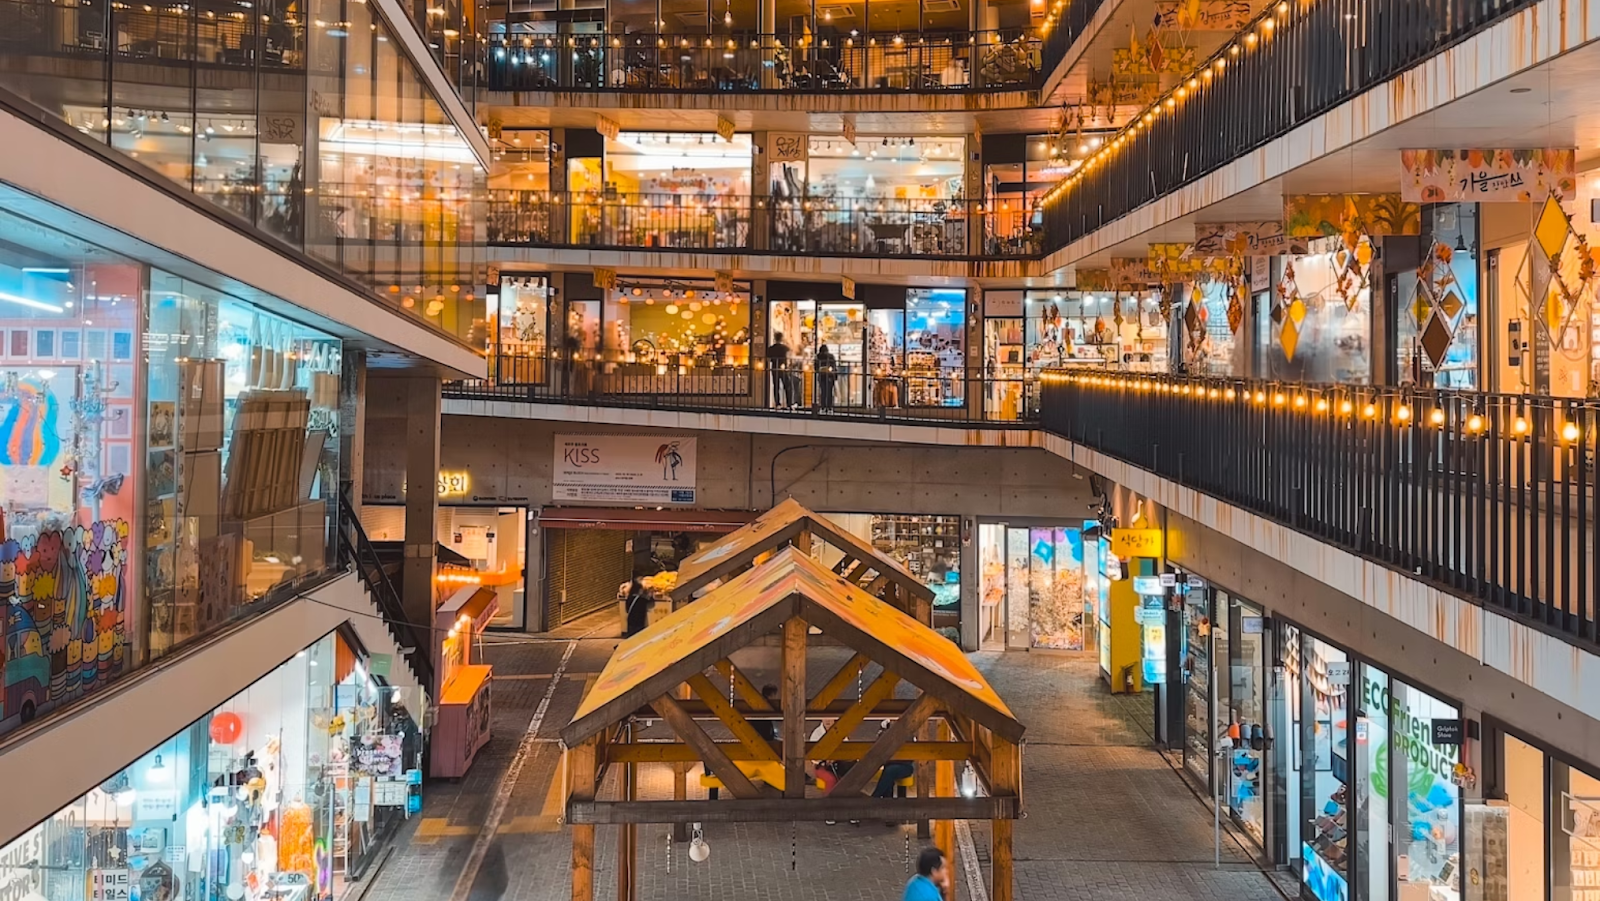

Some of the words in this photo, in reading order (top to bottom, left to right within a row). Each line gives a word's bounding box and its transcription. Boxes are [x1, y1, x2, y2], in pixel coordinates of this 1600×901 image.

[564, 448, 600, 467] KISS
[1121, 533, 1154, 548] 식당가
[1362, 676, 1389, 716] ECO
[1392, 697, 1458, 759] Frieny
